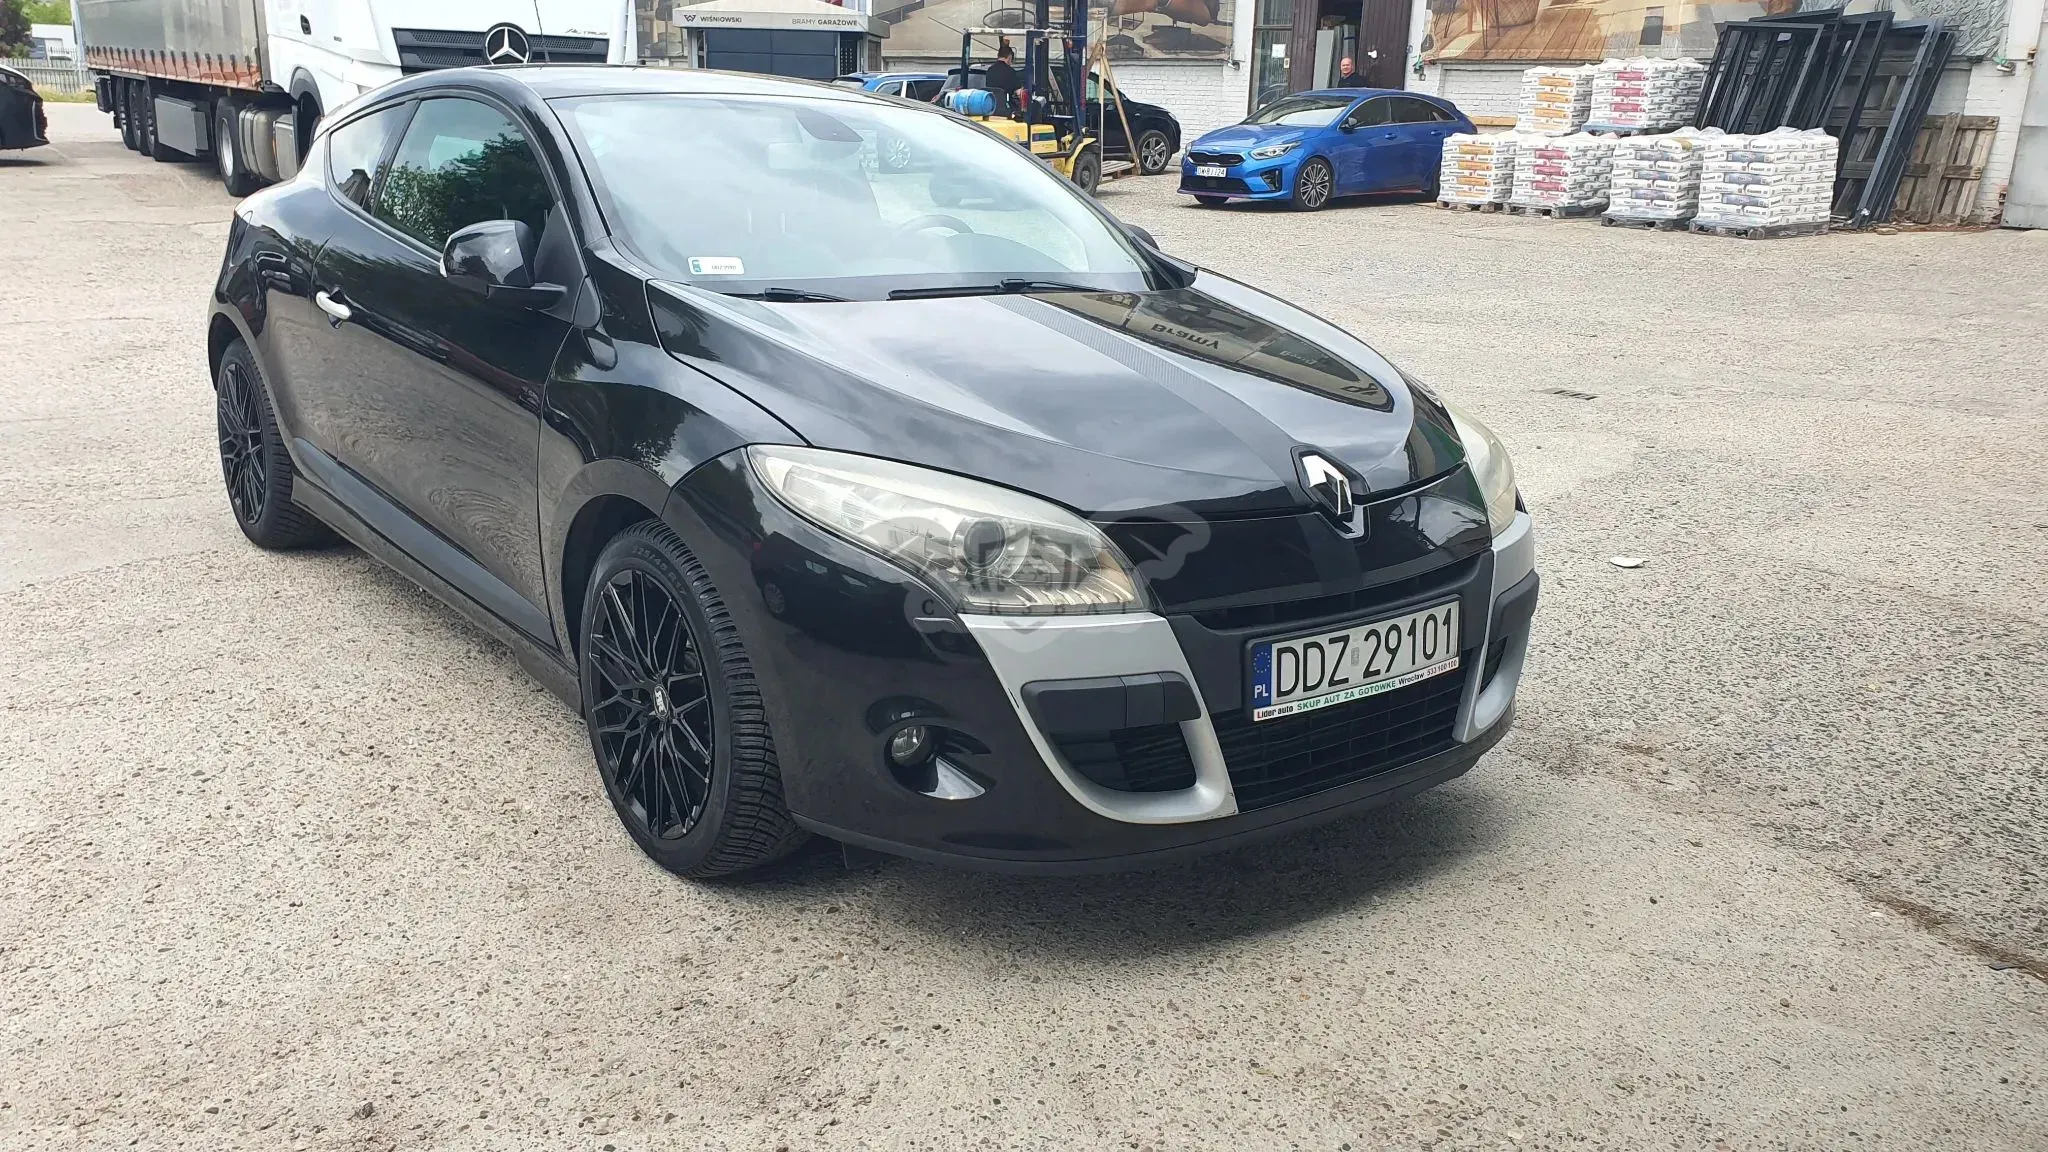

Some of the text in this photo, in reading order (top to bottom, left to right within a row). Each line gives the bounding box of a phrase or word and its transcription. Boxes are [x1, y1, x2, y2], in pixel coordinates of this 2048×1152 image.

[1276, 607, 1452, 698] DDZ 29101
[1254, 683, 1269, 699] PL
[1257, 707, 1277, 719] Lider
[1277, 704, 1294, 715] auto
[1297, 698, 1321, 711] SKUP
[1323, 693, 1341, 705] AUT
[1343, 689, 1355, 699] ZA
